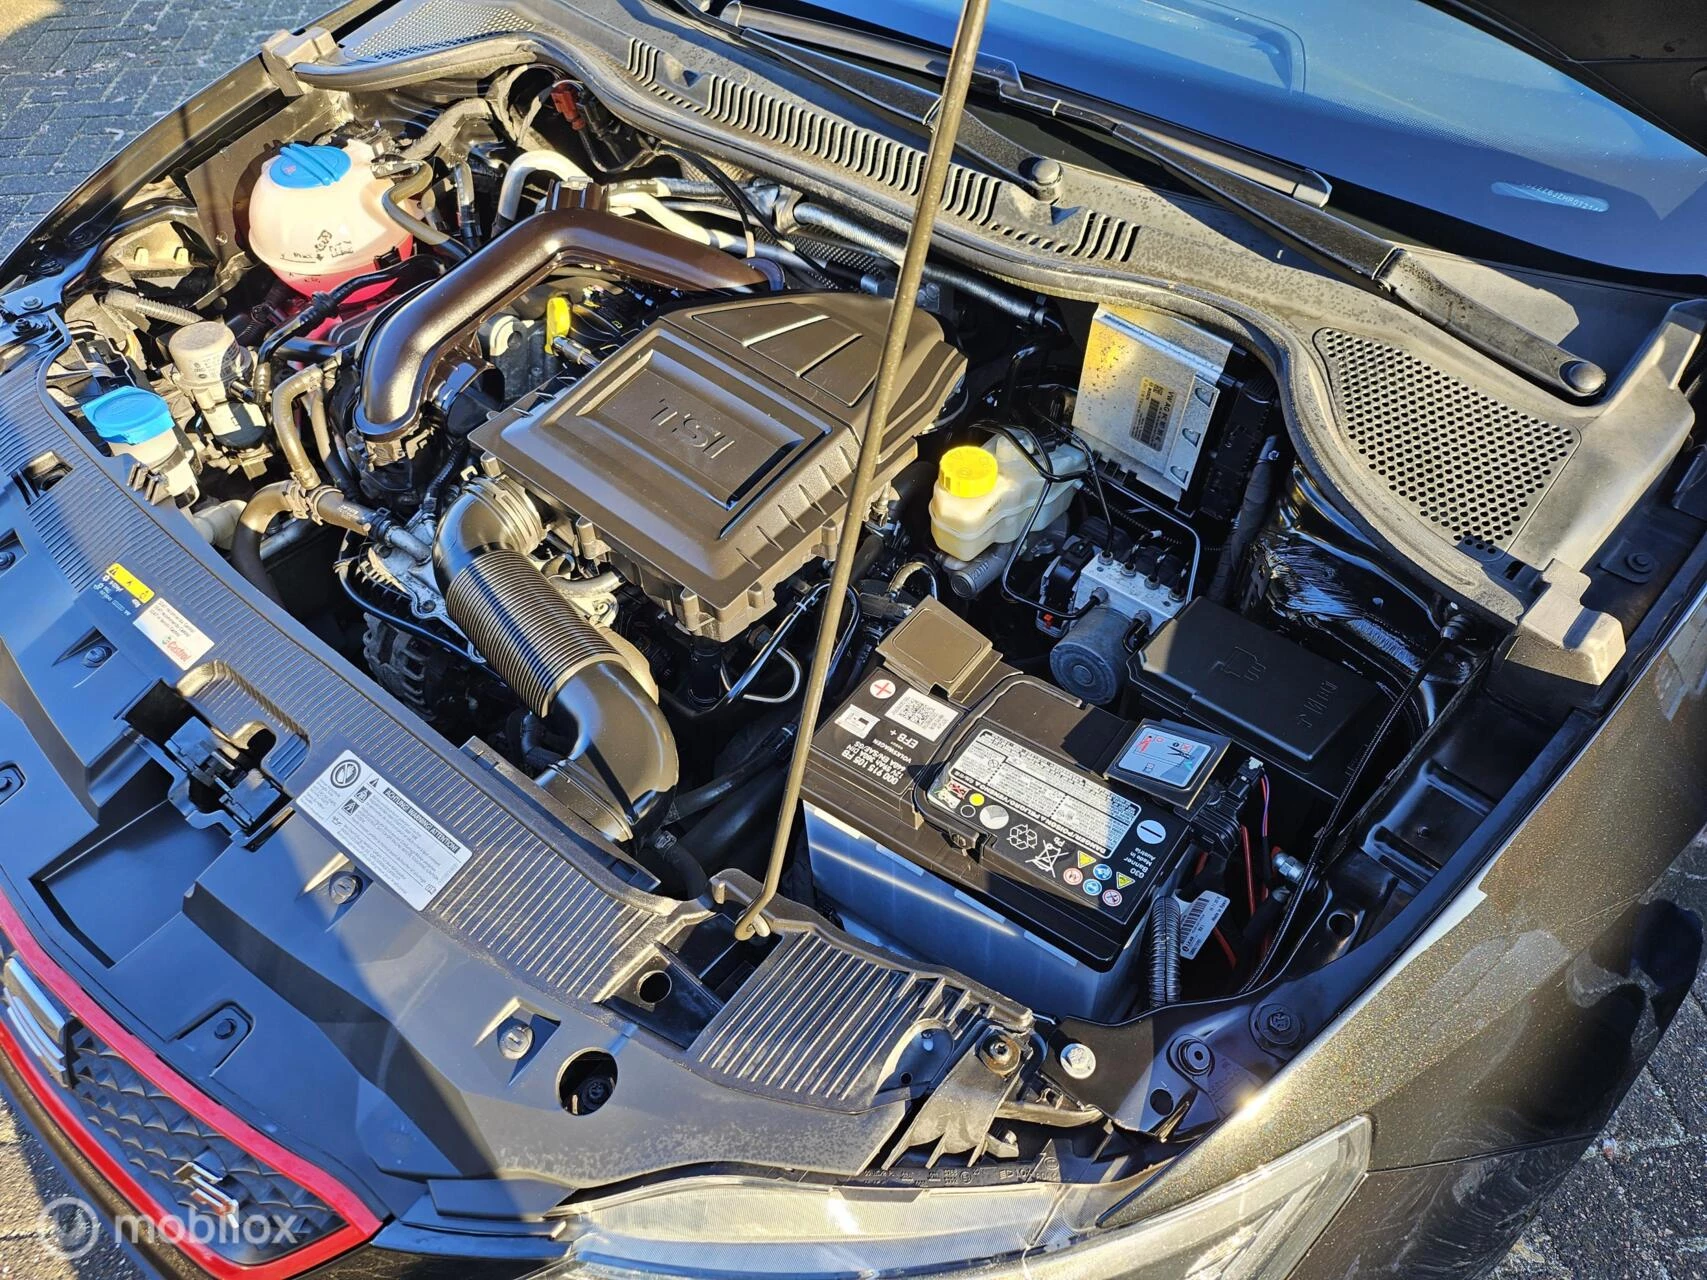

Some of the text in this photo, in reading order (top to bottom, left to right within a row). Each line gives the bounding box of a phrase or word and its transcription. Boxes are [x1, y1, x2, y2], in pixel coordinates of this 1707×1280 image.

[651, 399, 735, 458] TSI
[166, 639, 192, 662] Castrol
[847, 744, 860, 753] DIN
[897, 732, 919, 749] EFB
[873, 738, 912, 763] VOLKSWAGEN
[841, 749, 899, 785] 000 915 105 FB
[892, 769, 904, 778] 12V
[385, 789, 458, 852] ACHTUNG! WARNING! ATTENTION!
[1053, 836, 1065, 847] Pb
[1134, 847, 1156, 861] Austria
[1136, 855, 1152, 866] Made
[1124, 856, 1148, 872] Banner
